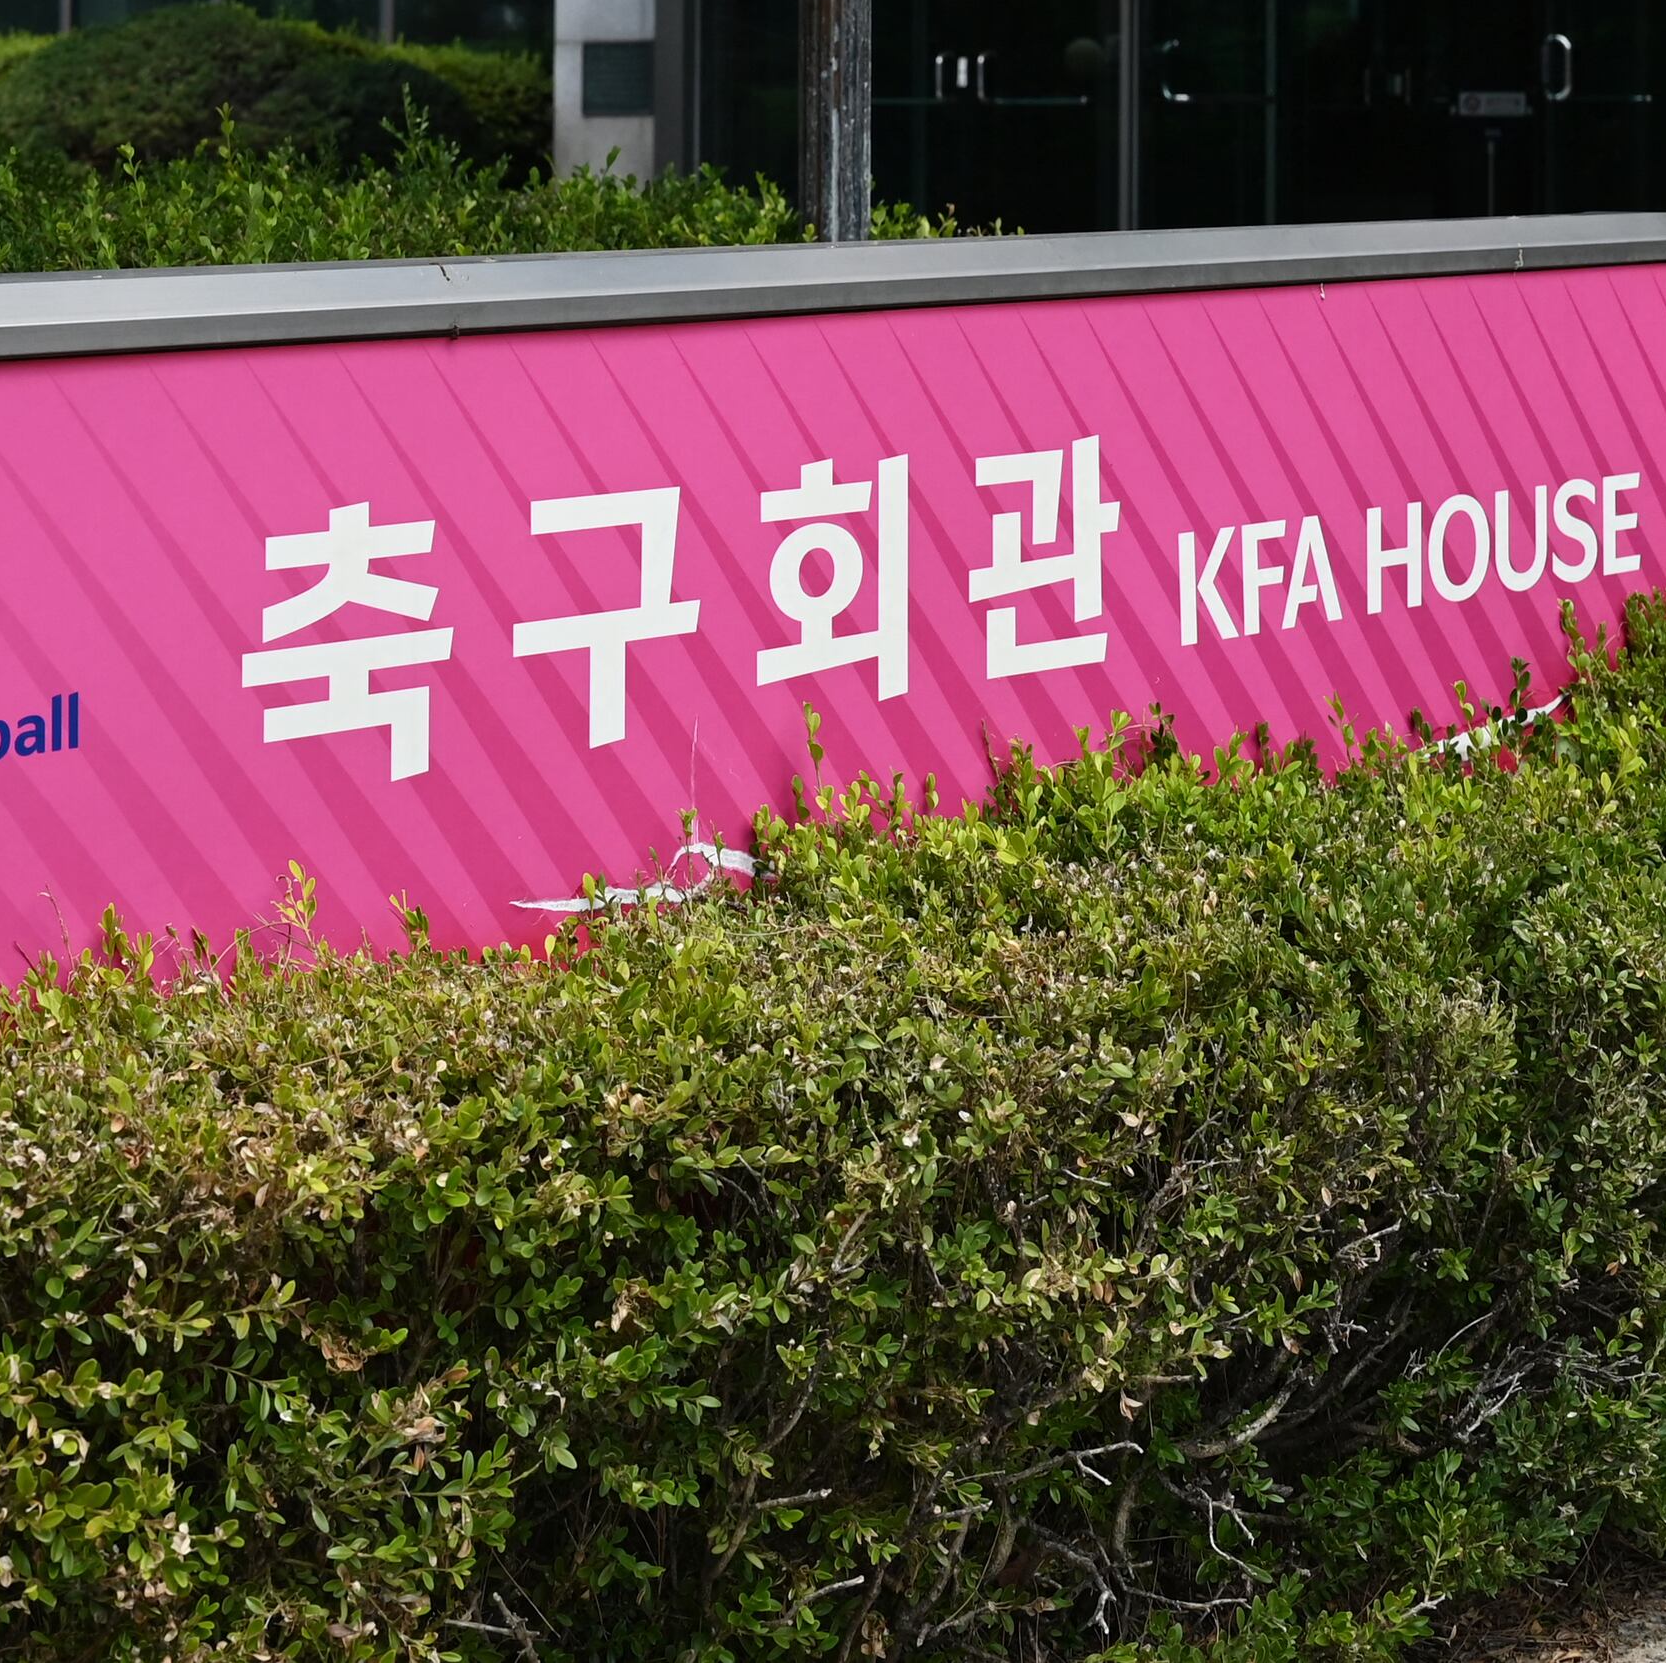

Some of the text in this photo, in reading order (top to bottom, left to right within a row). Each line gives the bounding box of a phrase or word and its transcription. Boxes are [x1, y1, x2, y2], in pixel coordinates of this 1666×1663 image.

[241, 434, 1641, 781] 축구회관 KFA HOUSE
